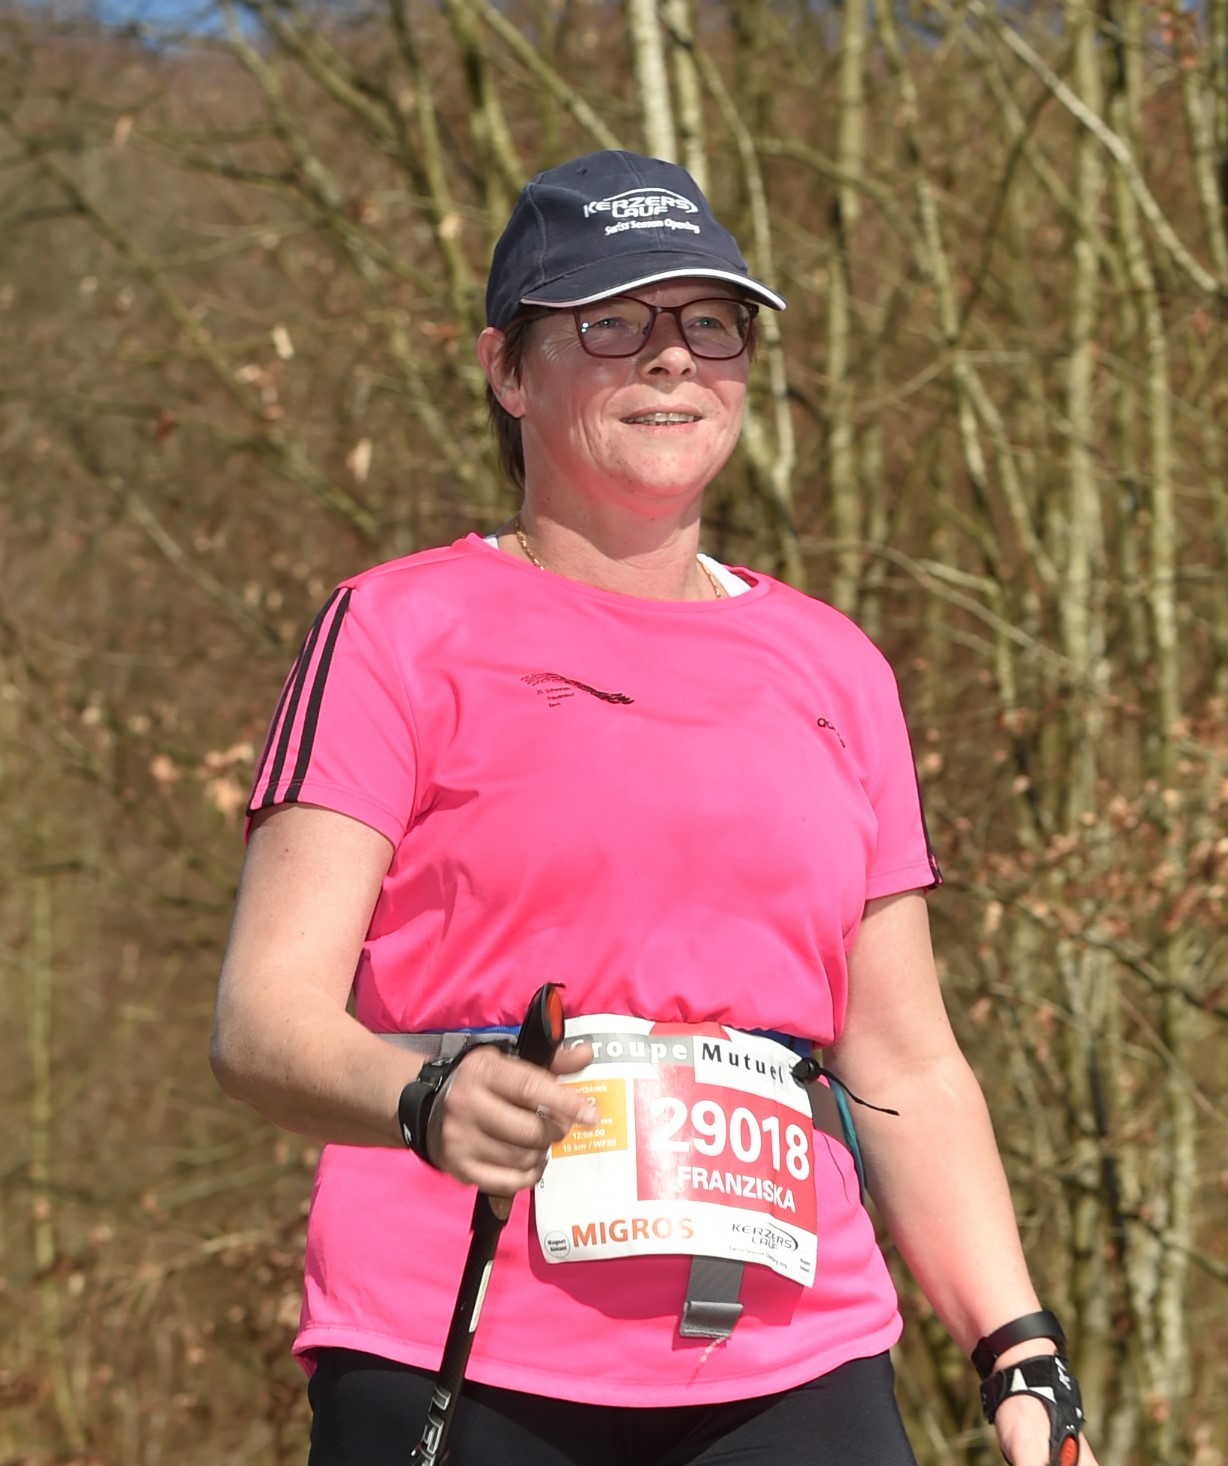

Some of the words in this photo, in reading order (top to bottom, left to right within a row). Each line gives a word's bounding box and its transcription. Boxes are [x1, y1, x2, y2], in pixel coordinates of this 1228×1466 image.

[583, 196, 690, 218] KERZERS
[612, 206, 668, 218] LAUF
[664, 218, 700, 234] Opening
[702, 1042, 785, 1085] Mutuel
[650, 1096, 810, 1181] 29018
[677, 1165, 797, 1213] FRANZISKA
[571, 1217, 695, 1249] MIGROS
[732, 1223, 793, 1249] KERZERS
